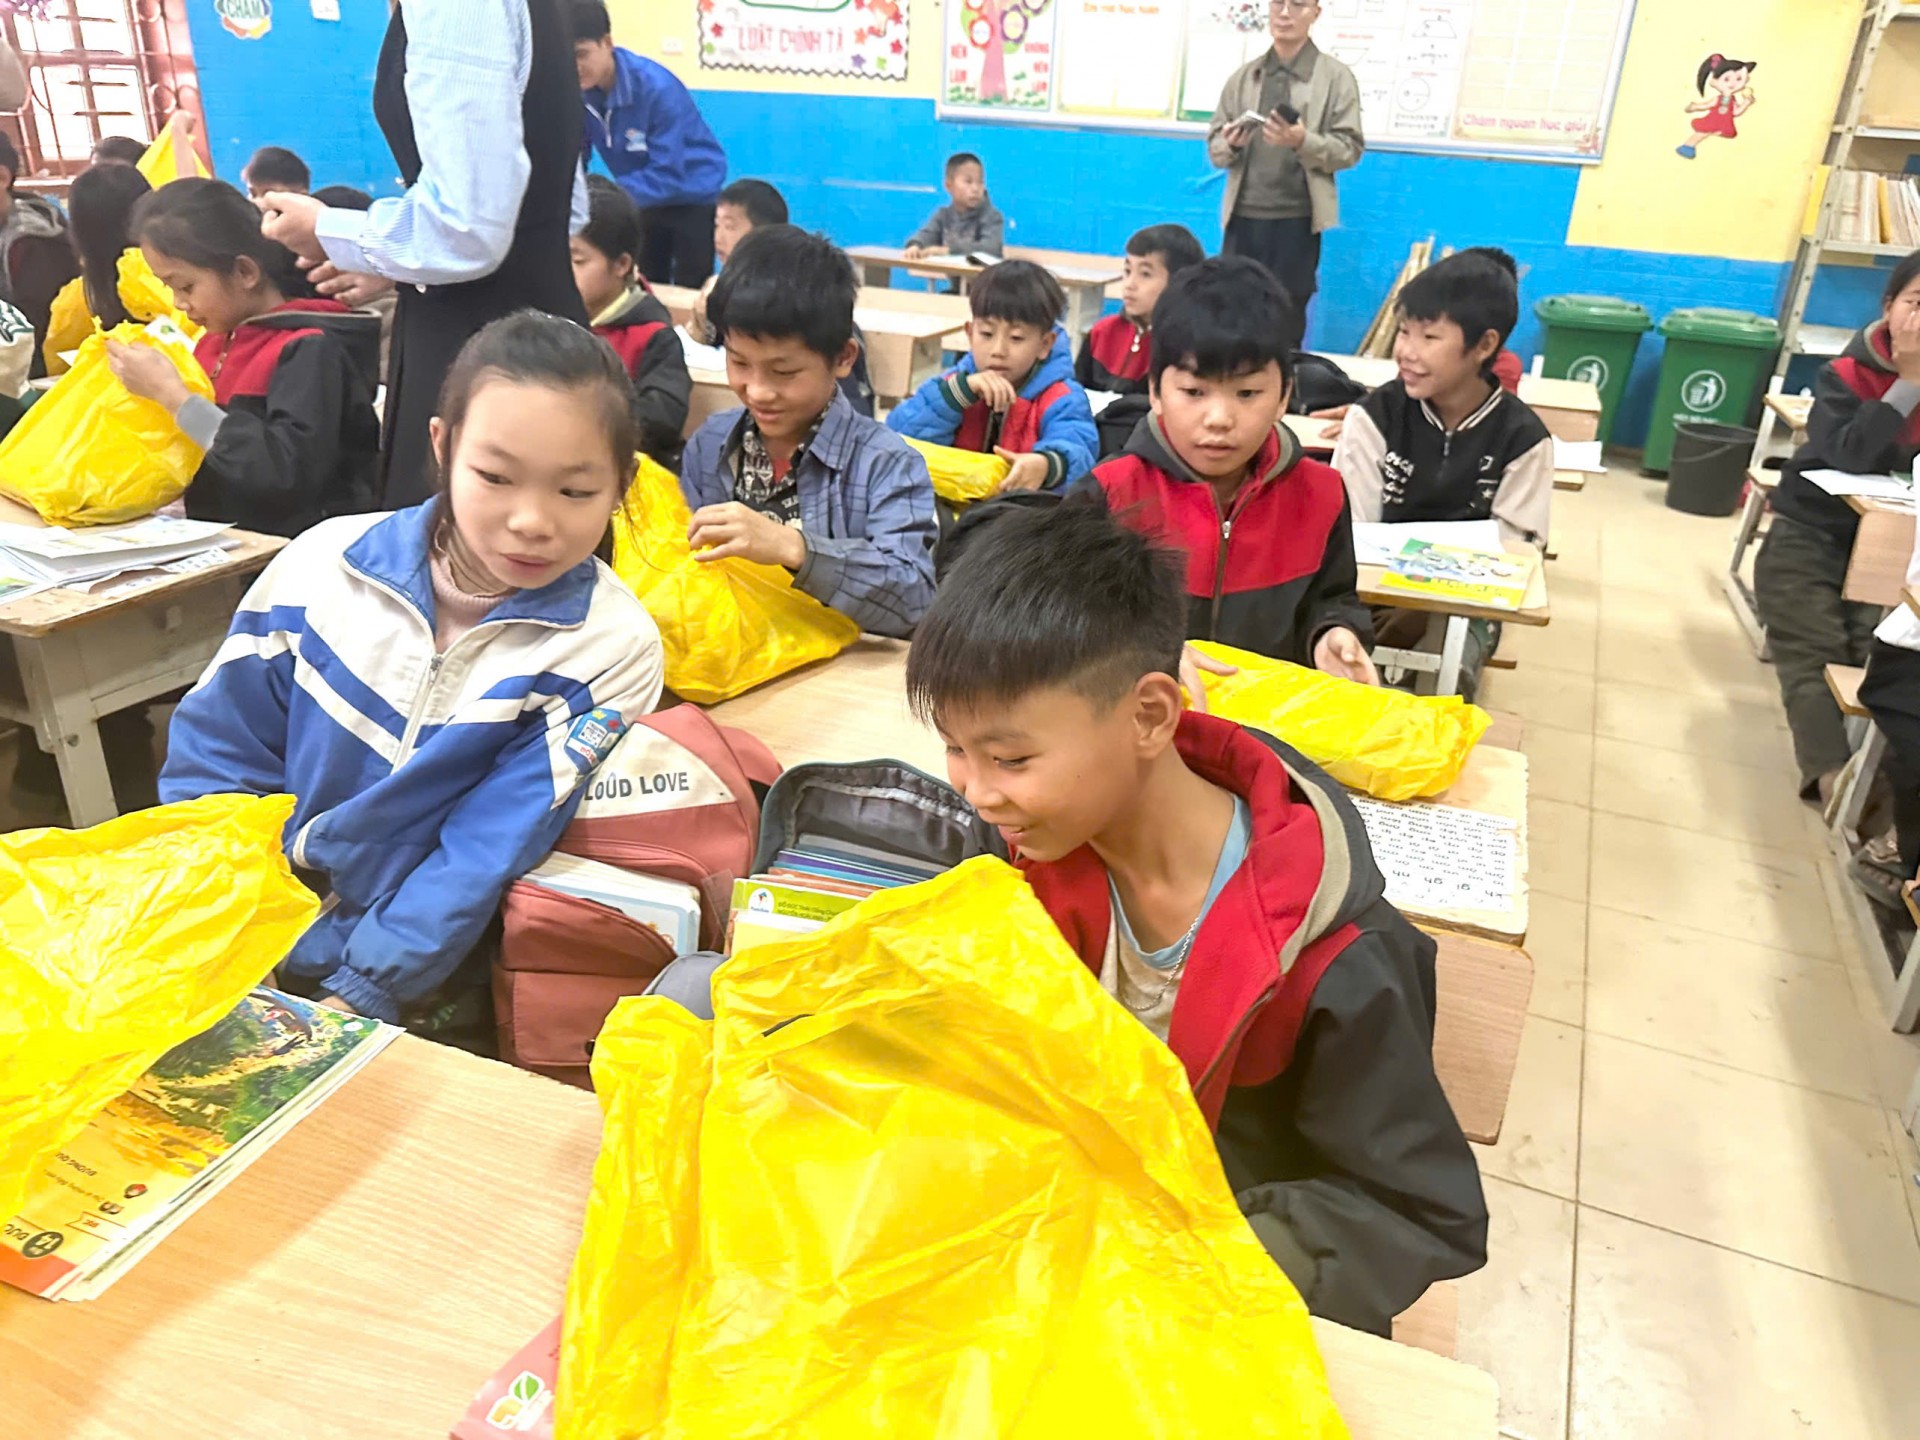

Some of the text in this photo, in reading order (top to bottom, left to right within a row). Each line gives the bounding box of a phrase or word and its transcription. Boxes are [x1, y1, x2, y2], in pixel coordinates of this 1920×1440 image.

[640, 772, 690, 796] LOVE
[1392, 869, 1410, 877] nh
[1423, 876, 1443, 884] gh
